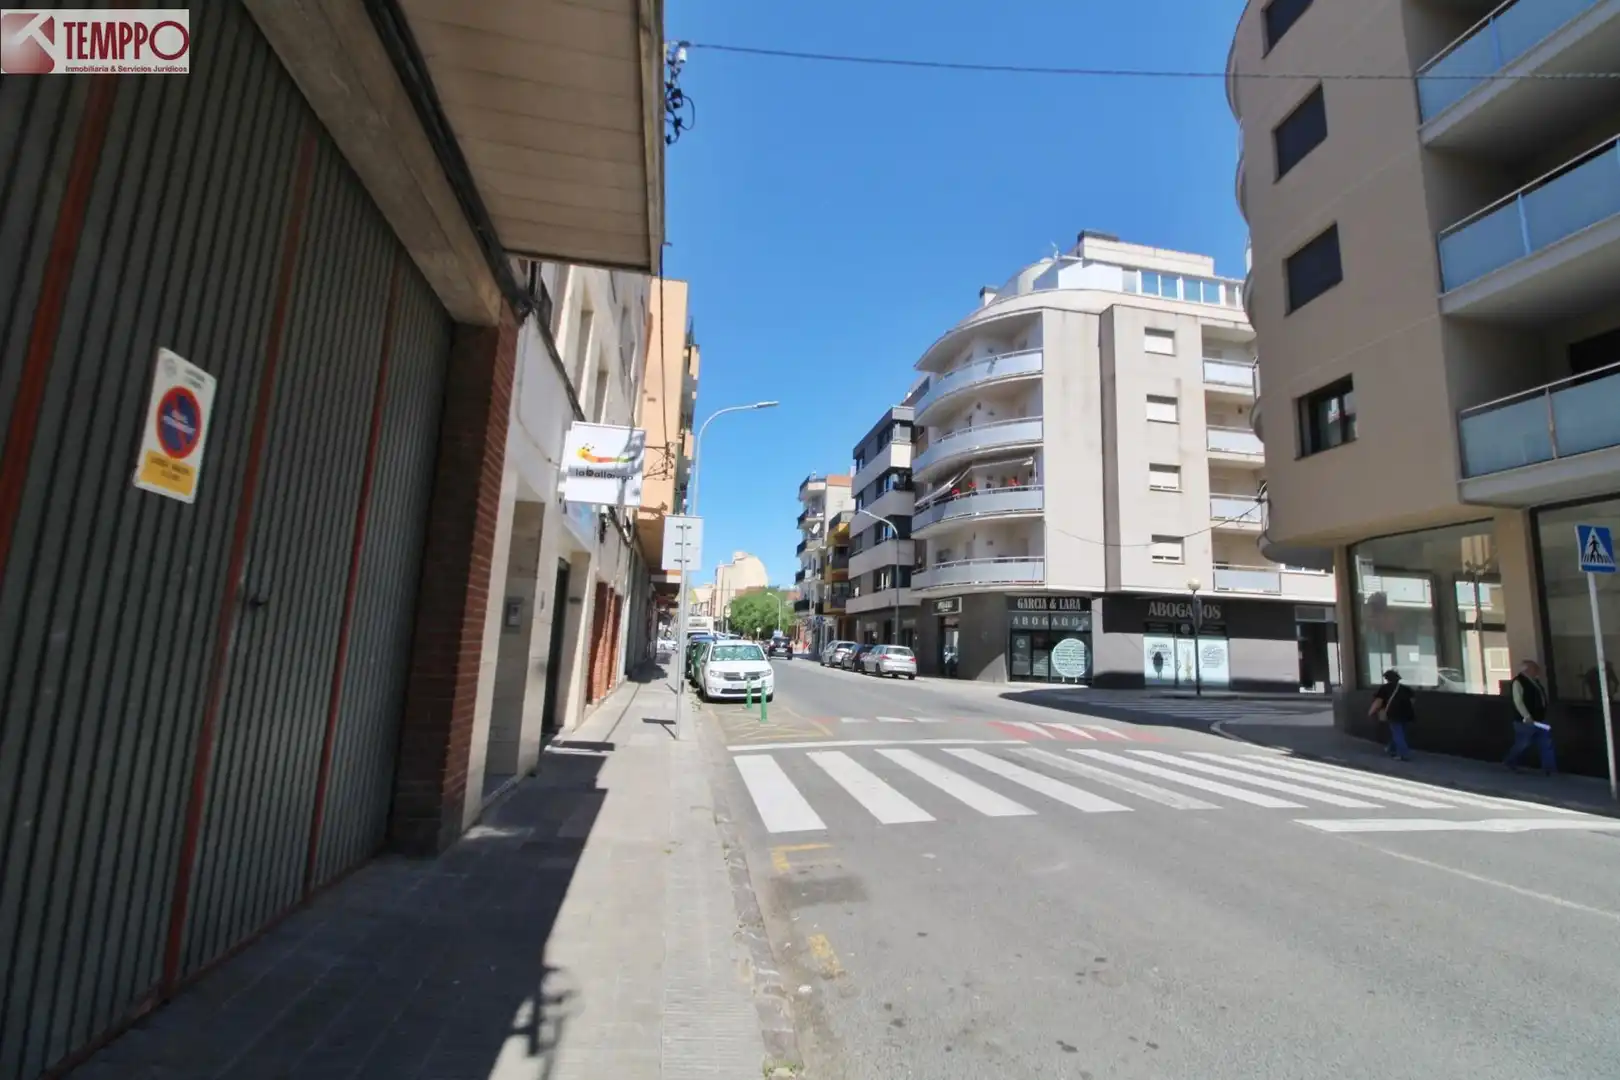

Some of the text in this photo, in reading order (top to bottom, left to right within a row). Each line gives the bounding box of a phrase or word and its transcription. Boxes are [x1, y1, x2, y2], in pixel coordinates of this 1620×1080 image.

[1049, 598, 1057, 609] &
[1059, 598, 1081, 610] LARA
[1148, 601, 1222, 619] ABOGAOS
